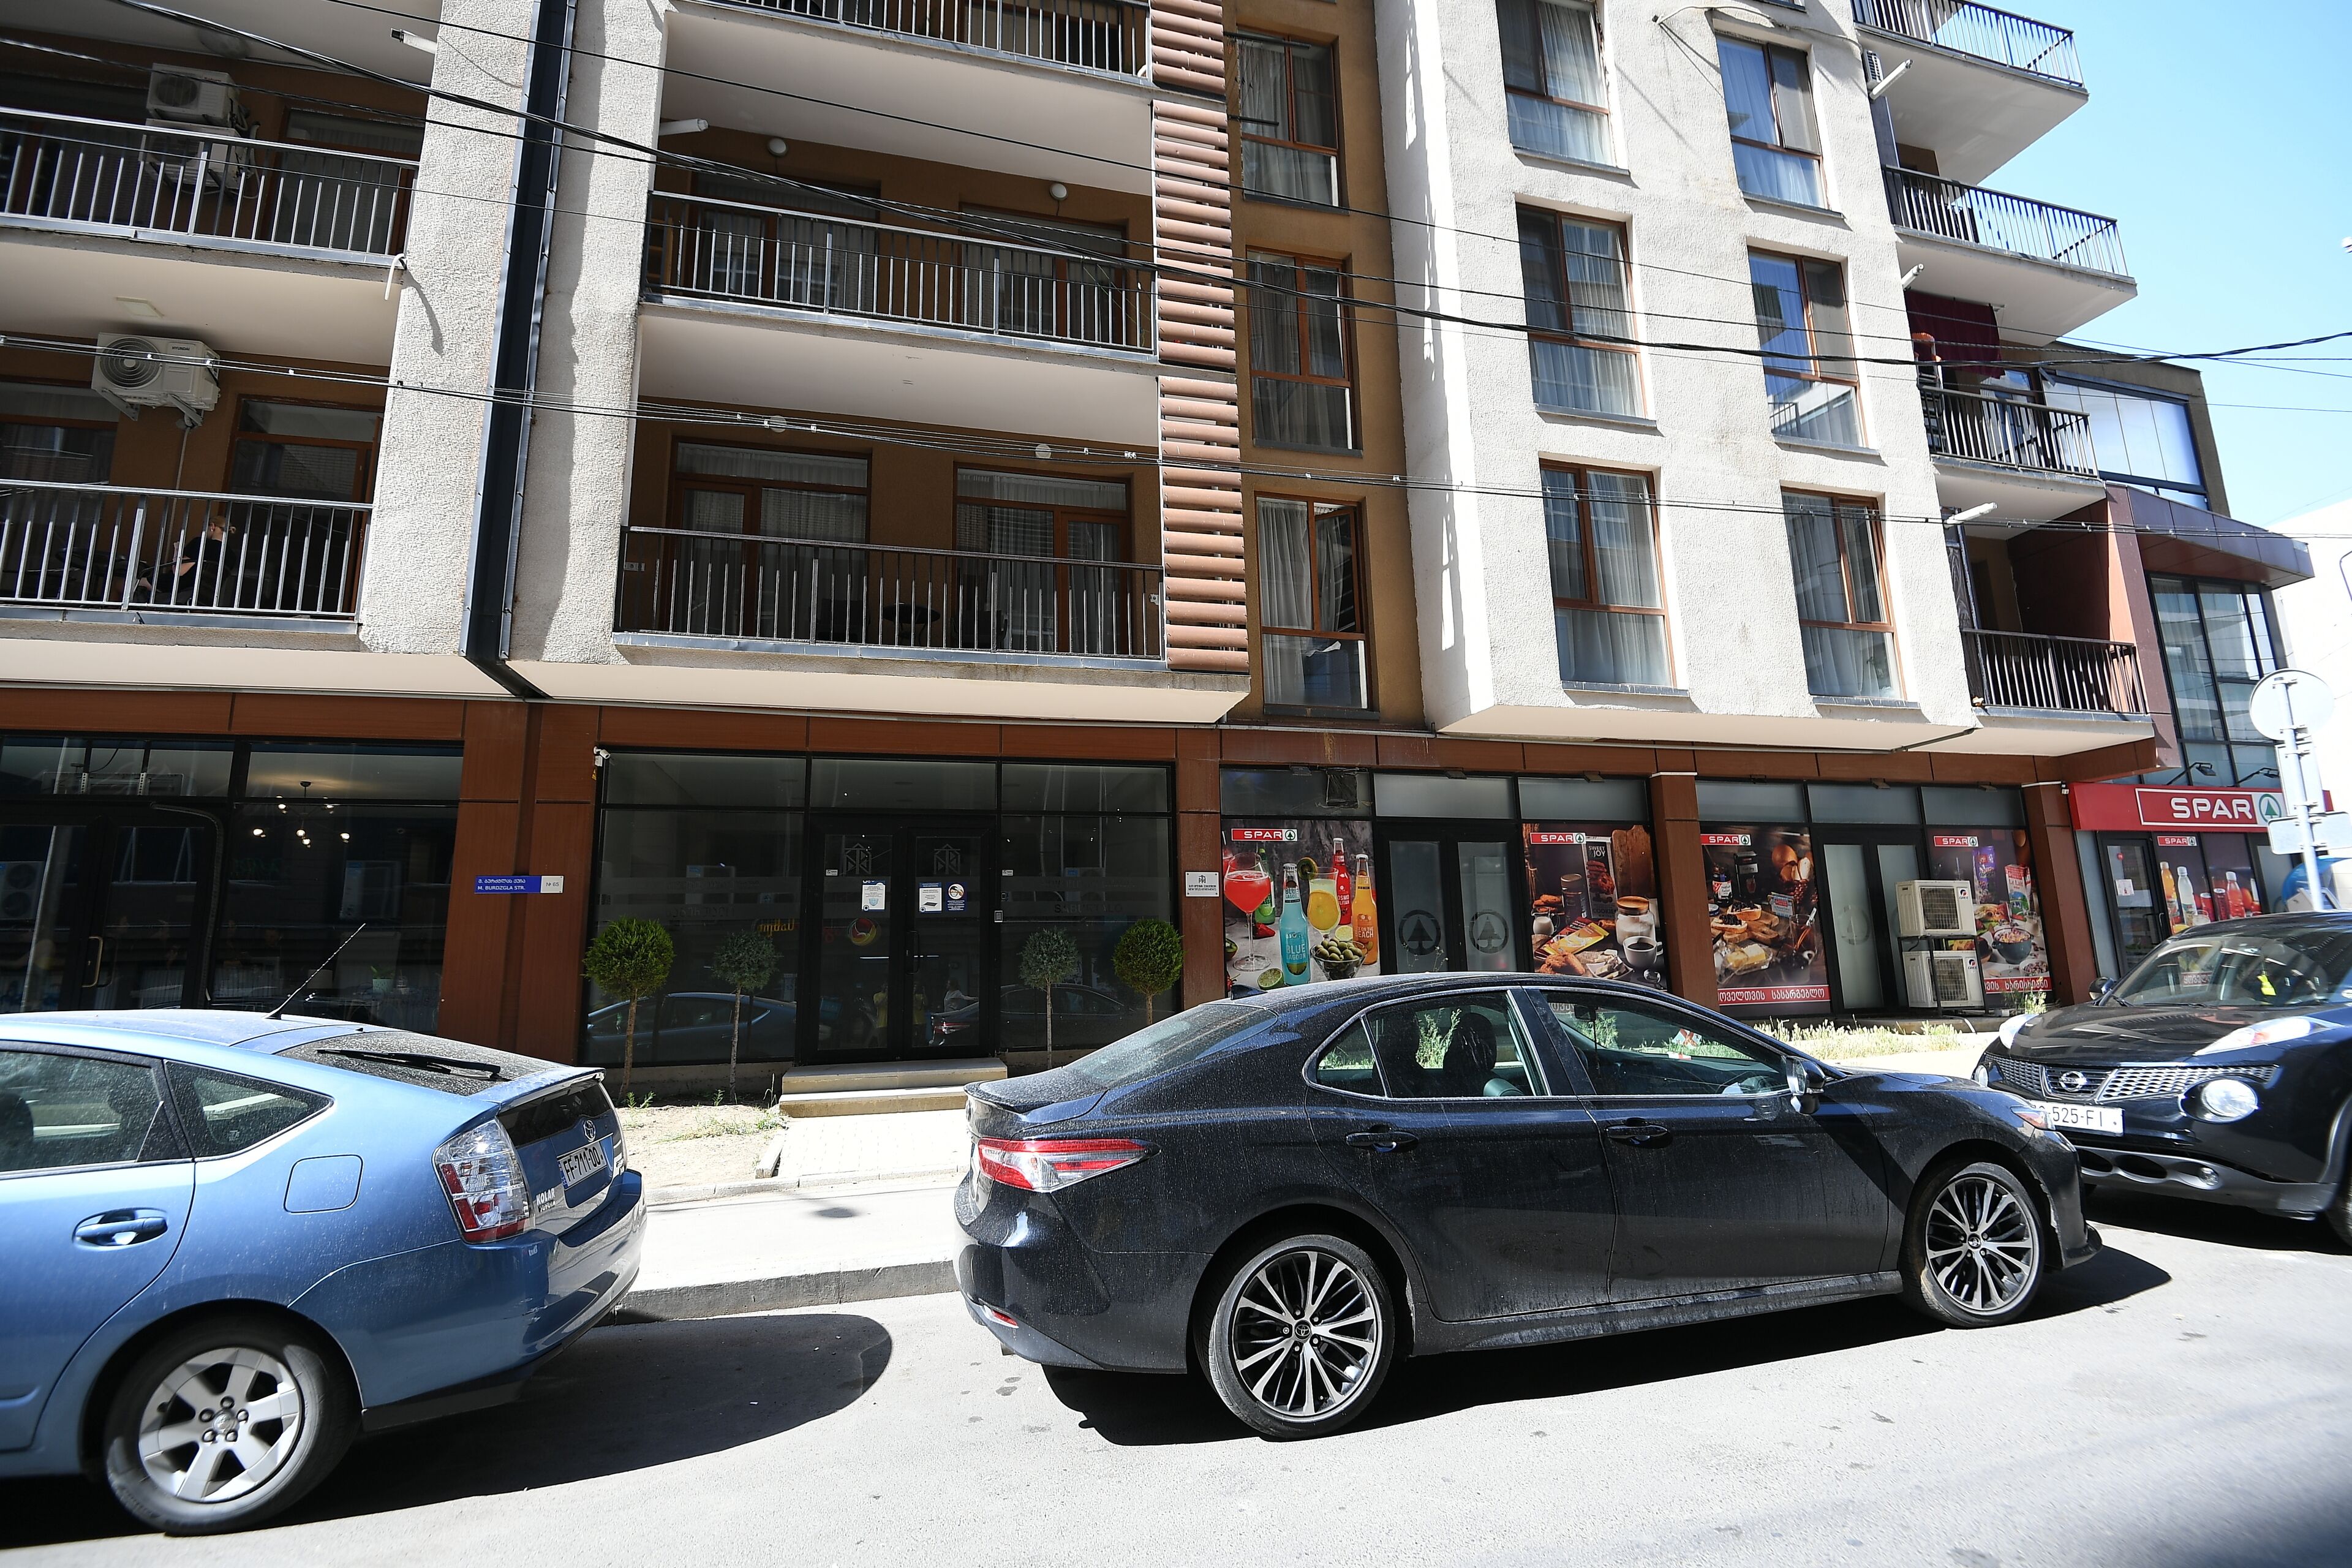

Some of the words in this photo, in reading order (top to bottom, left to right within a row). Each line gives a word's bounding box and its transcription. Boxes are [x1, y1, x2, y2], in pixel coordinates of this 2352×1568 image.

[2171, 797, 2253, 819] SPAR
[1286, 944, 1305, 954] BLUE
[1771, 988, 1825, 1000] სასარგებლო
[2030, 1104, 2102, 1126] -525-FI
[563, 1147, 601, 1182] FF-711-00
[536, 1188, 556, 1205] KOLAR
